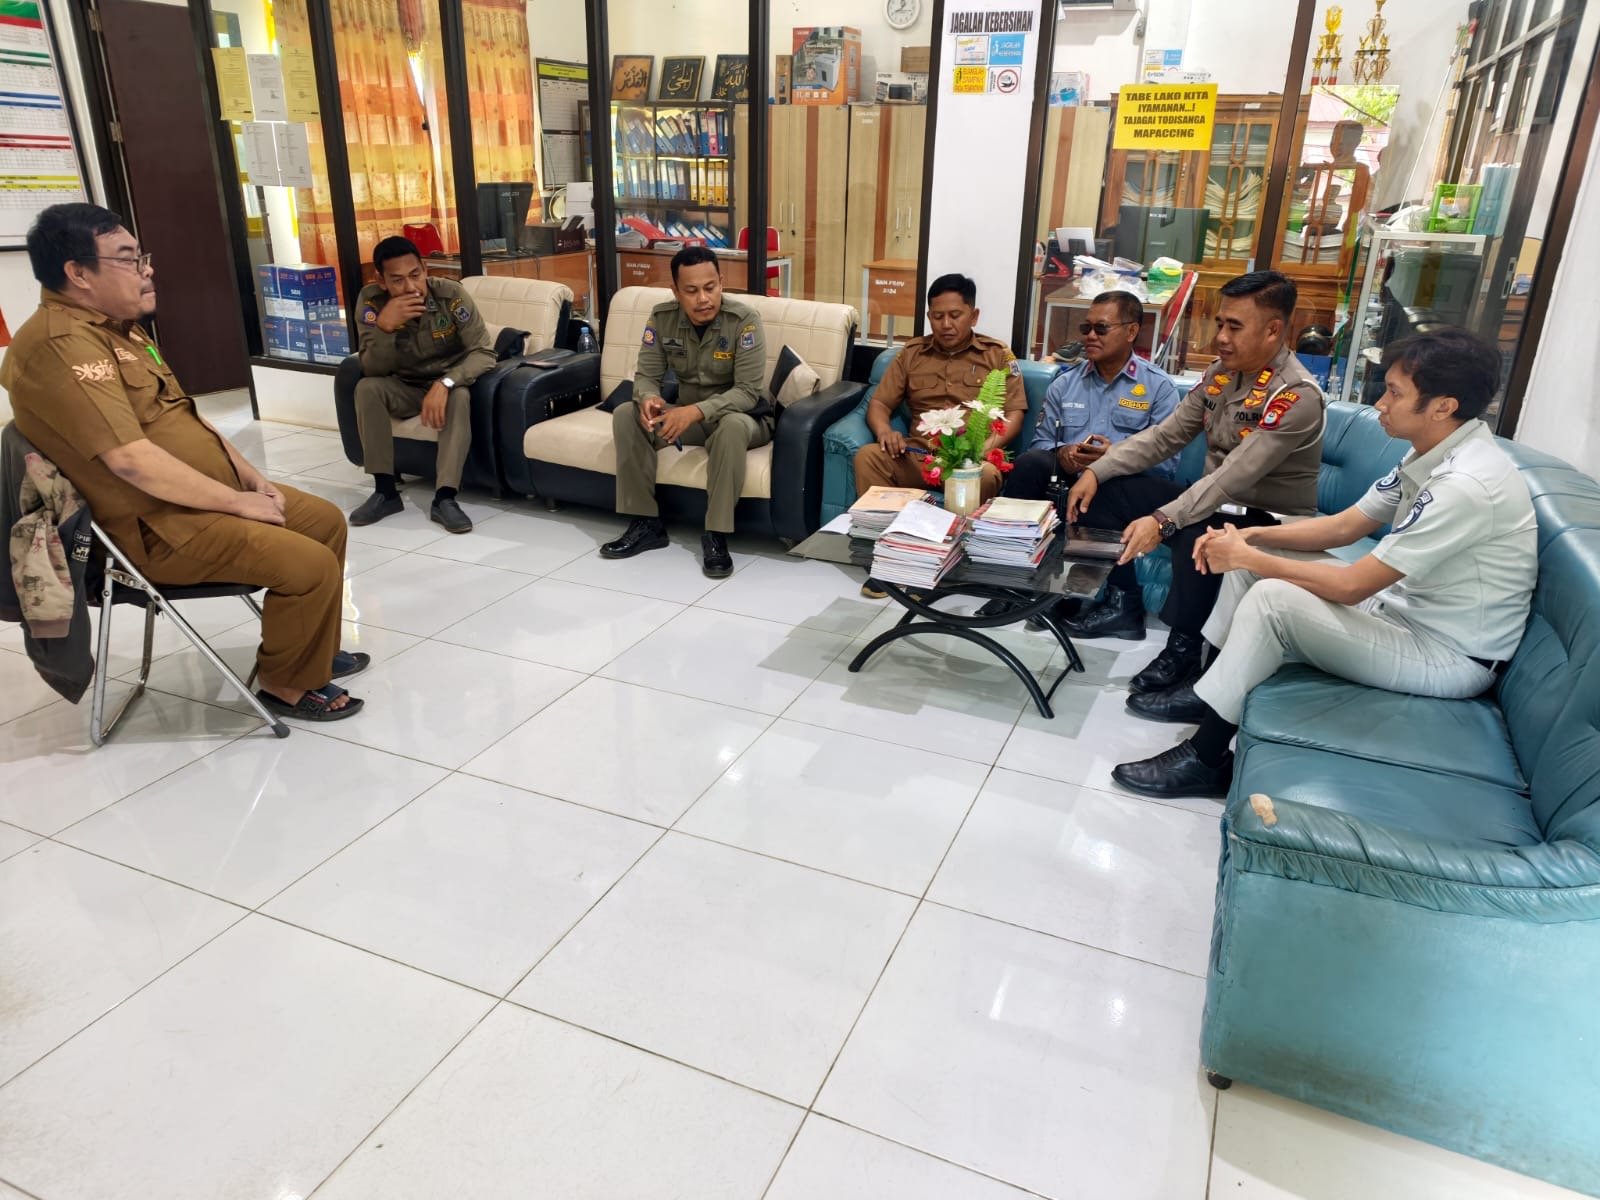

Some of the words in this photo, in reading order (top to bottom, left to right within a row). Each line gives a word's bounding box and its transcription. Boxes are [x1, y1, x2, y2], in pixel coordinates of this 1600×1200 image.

[950, 12, 983, 33] JAGALAH
[984, 11, 1033, 32] KEBERSIHAN
[1125, 93, 1151, 101] TABE
[1154, 92, 1181, 100] LAKO
[1183, 91, 1208, 100] KITA
[1123, 116, 1156, 124] TAJAGAI
[1133, 129, 1195, 138] MAPACCING
